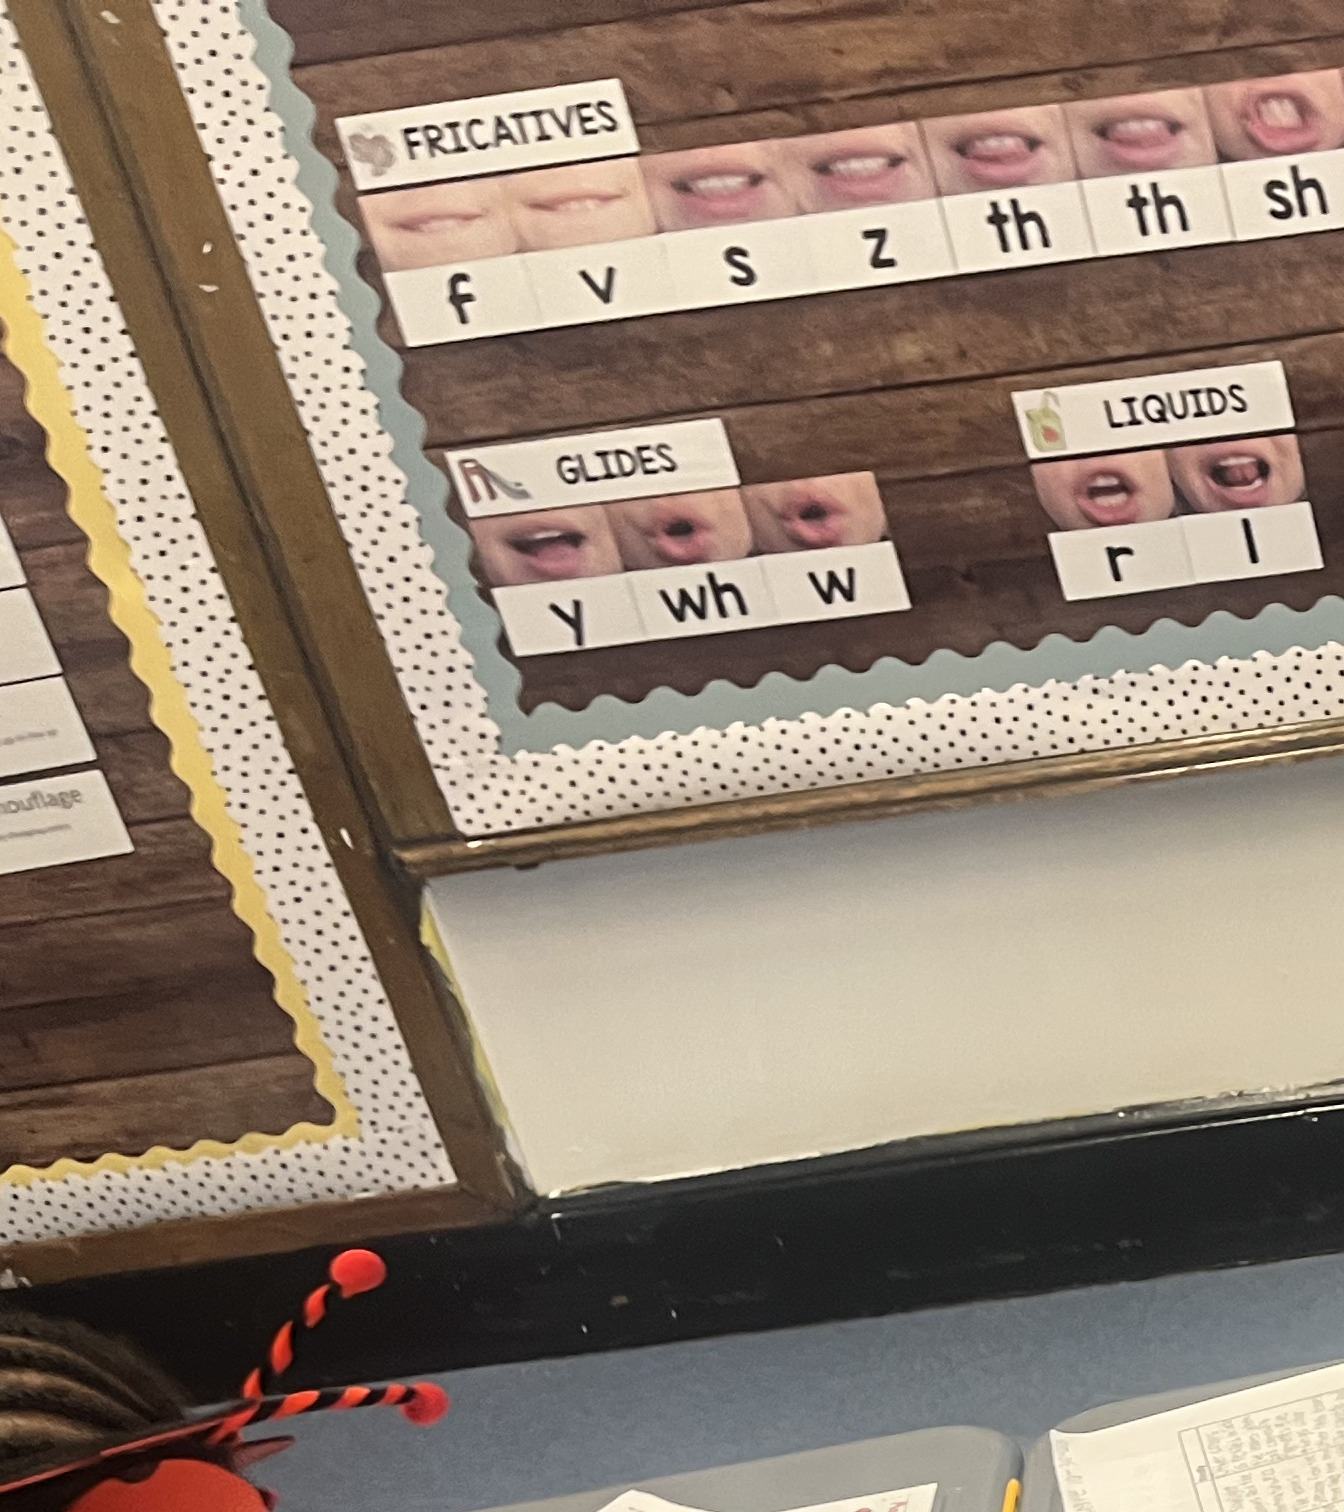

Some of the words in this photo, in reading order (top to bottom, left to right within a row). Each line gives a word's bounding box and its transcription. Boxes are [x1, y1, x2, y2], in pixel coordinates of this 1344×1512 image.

[402, 99, 621, 161] FRICATIVES
[446, 271, 478, 326] f
[577, 265, 618, 305] v
[722, 245, 757, 288] s
[860, 227, 897, 270] z
[985, 198, 1054, 254] th
[1124, 183, 1192, 237] th
[1263, 165, 1332, 222] sh
[1102, 382, 1251, 431] LIQUIDS
[554, 443, 679, 487] GLIDES
[1103, 541, 1136, 584] r
[1241, 518, 1261, 566] l
[548, 598, 588, 647] y
[659, 572, 750, 624] wh
[807, 566, 857, 606] w
[0, 789, 82, 814] ouflage
